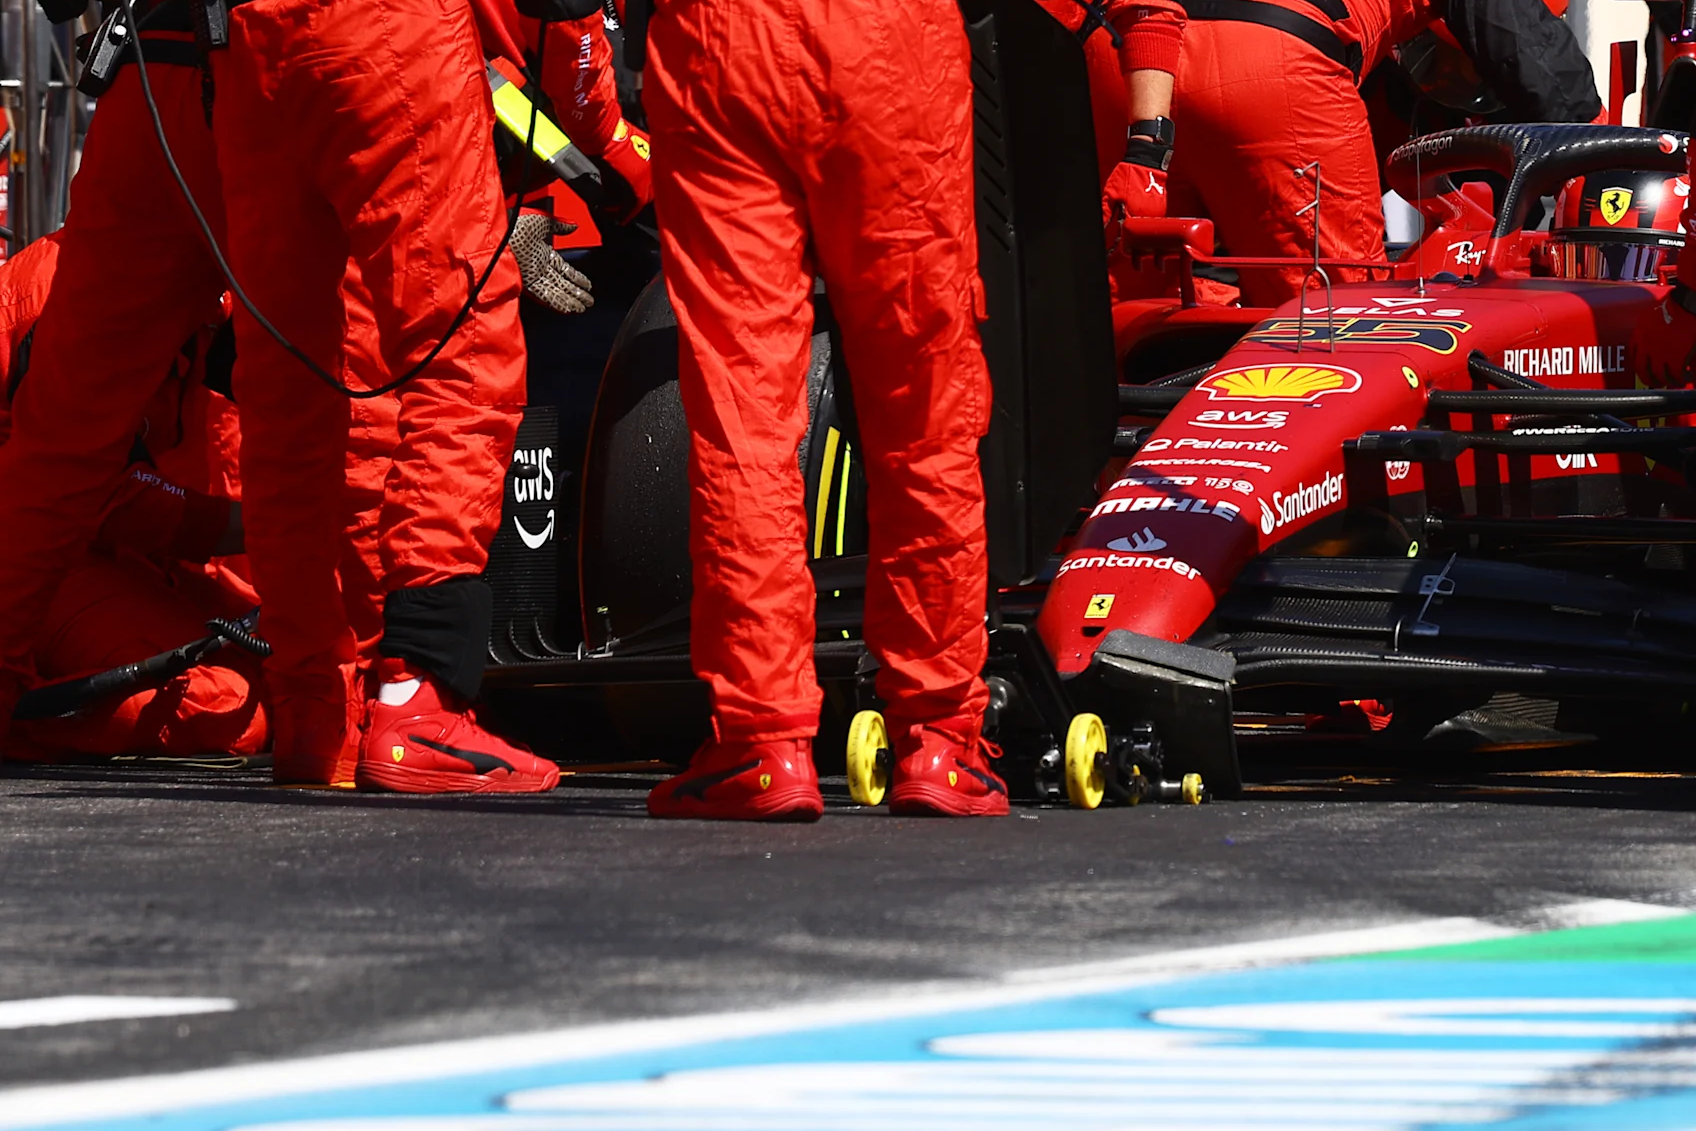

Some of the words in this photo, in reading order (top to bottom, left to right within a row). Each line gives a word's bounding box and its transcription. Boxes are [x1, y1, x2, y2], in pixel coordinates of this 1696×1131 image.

[1303, 306, 1466, 317] VELAS
[1236, 317, 1472, 355] 55
[1504, 346, 1573, 377] RICHARD
[1577, 345, 1626, 374] MILLE
[1196, 410, 1290, 422] aws
[1174, 438, 1289, 453] Palantir
[513, 447, 554, 503] aws
[1090, 497, 1241, 522] MAHLE
[1272, 471, 1344, 528] Santander
[1055, 554, 1202, 581] Santander
